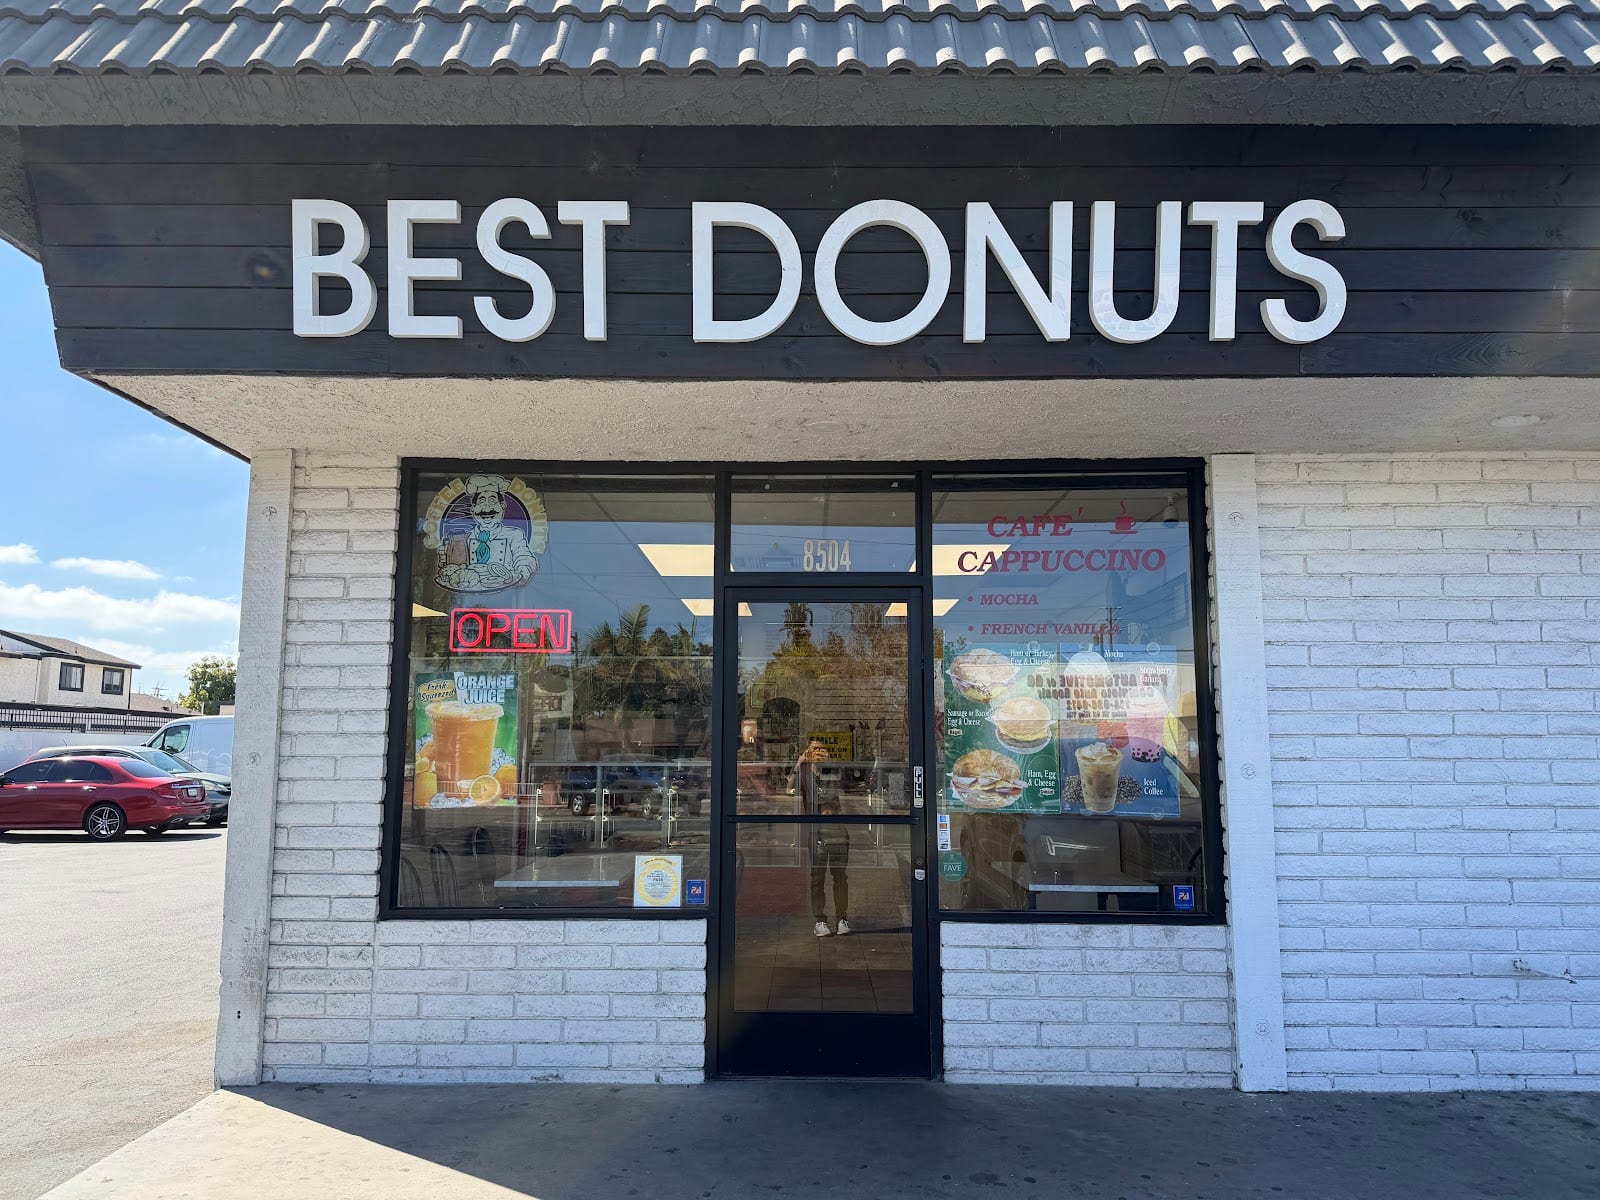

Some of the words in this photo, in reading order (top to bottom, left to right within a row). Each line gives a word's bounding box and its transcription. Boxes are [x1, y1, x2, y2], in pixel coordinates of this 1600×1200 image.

[291, 197, 630, 342] BEST
[692, 198, 1347, 345] DONUTS
[508, 476, 548, 555] DONUTS
[803, 538, 851, 572] 8504
[957, 548, 1166, 573] CAPPUCCINO
[980, 594, 1039, 606] MOCHA
[457, 613, 565, 648] OPEN
[981, 623, 1048, 635] FRENCH
[1052, 623, 1121, 635] VANILLA
[1104, 650, 1124, 658] Mocha
[457, 675, 514, 689] ORANGE
[464, 689, 505, 704] JUICE
[948, 718, 957, 726] Egg
[1045, 770, 1057, 780] Egg
[1034, 779, 1055, 787] Cheese
[1144, 778, 1157, 786] Iced
[1144, 788, 1163, 796] Coffee
[943, 864, 962, 872] FAVE
